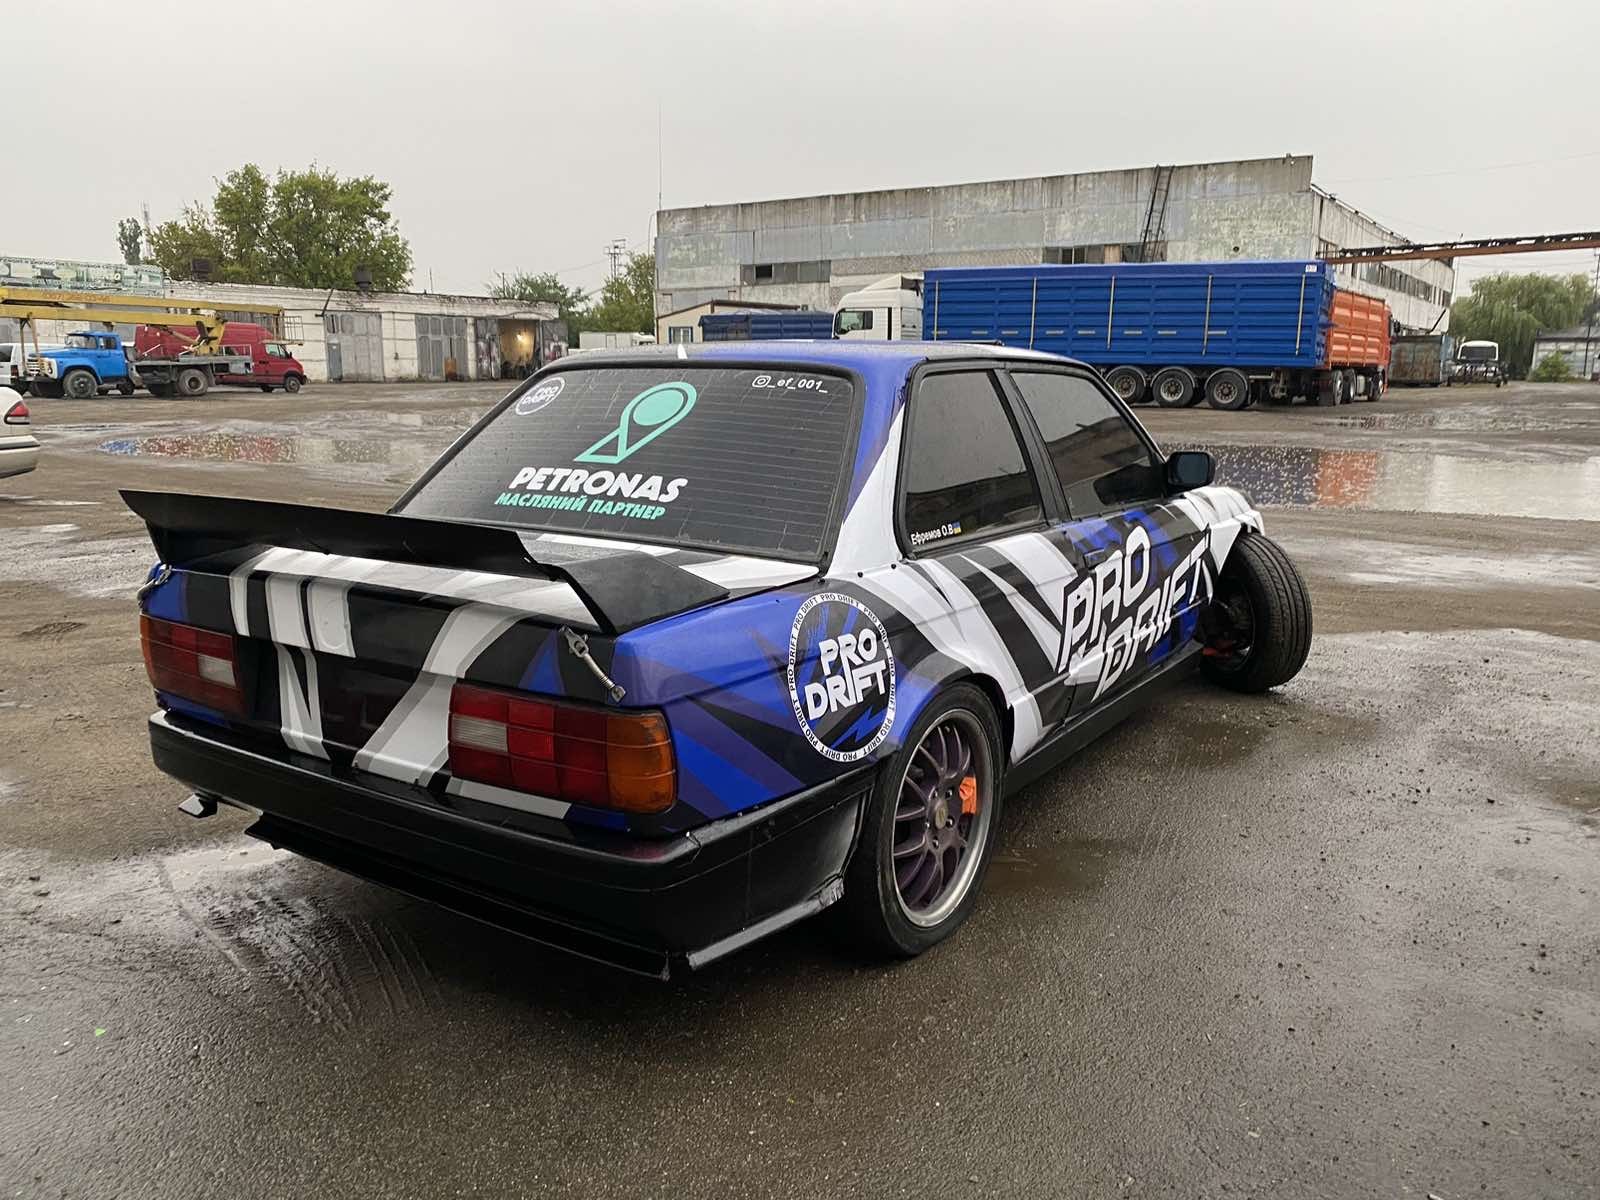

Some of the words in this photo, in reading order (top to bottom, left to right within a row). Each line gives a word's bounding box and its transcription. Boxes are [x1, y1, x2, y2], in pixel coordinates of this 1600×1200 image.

[509, 467, 688, 502] PETRONAS
[495, 492, 588, 511] МАСЛЯНИЙ
[587, 500, 666, 519] ПАРТНЕР
[793, 613, 804, 630] PRO
[801, 596, 818, 613] DRIFT
[1058, 526, 1151, 673] PRO
[819, 628, 878, 676] PRO
[804, 659, 887, 720] DRIFT
[882, 718, 892, 736] PRO
[842, 751, 857, 761] PRO
[862, 736, 882, 756] DRIFT
